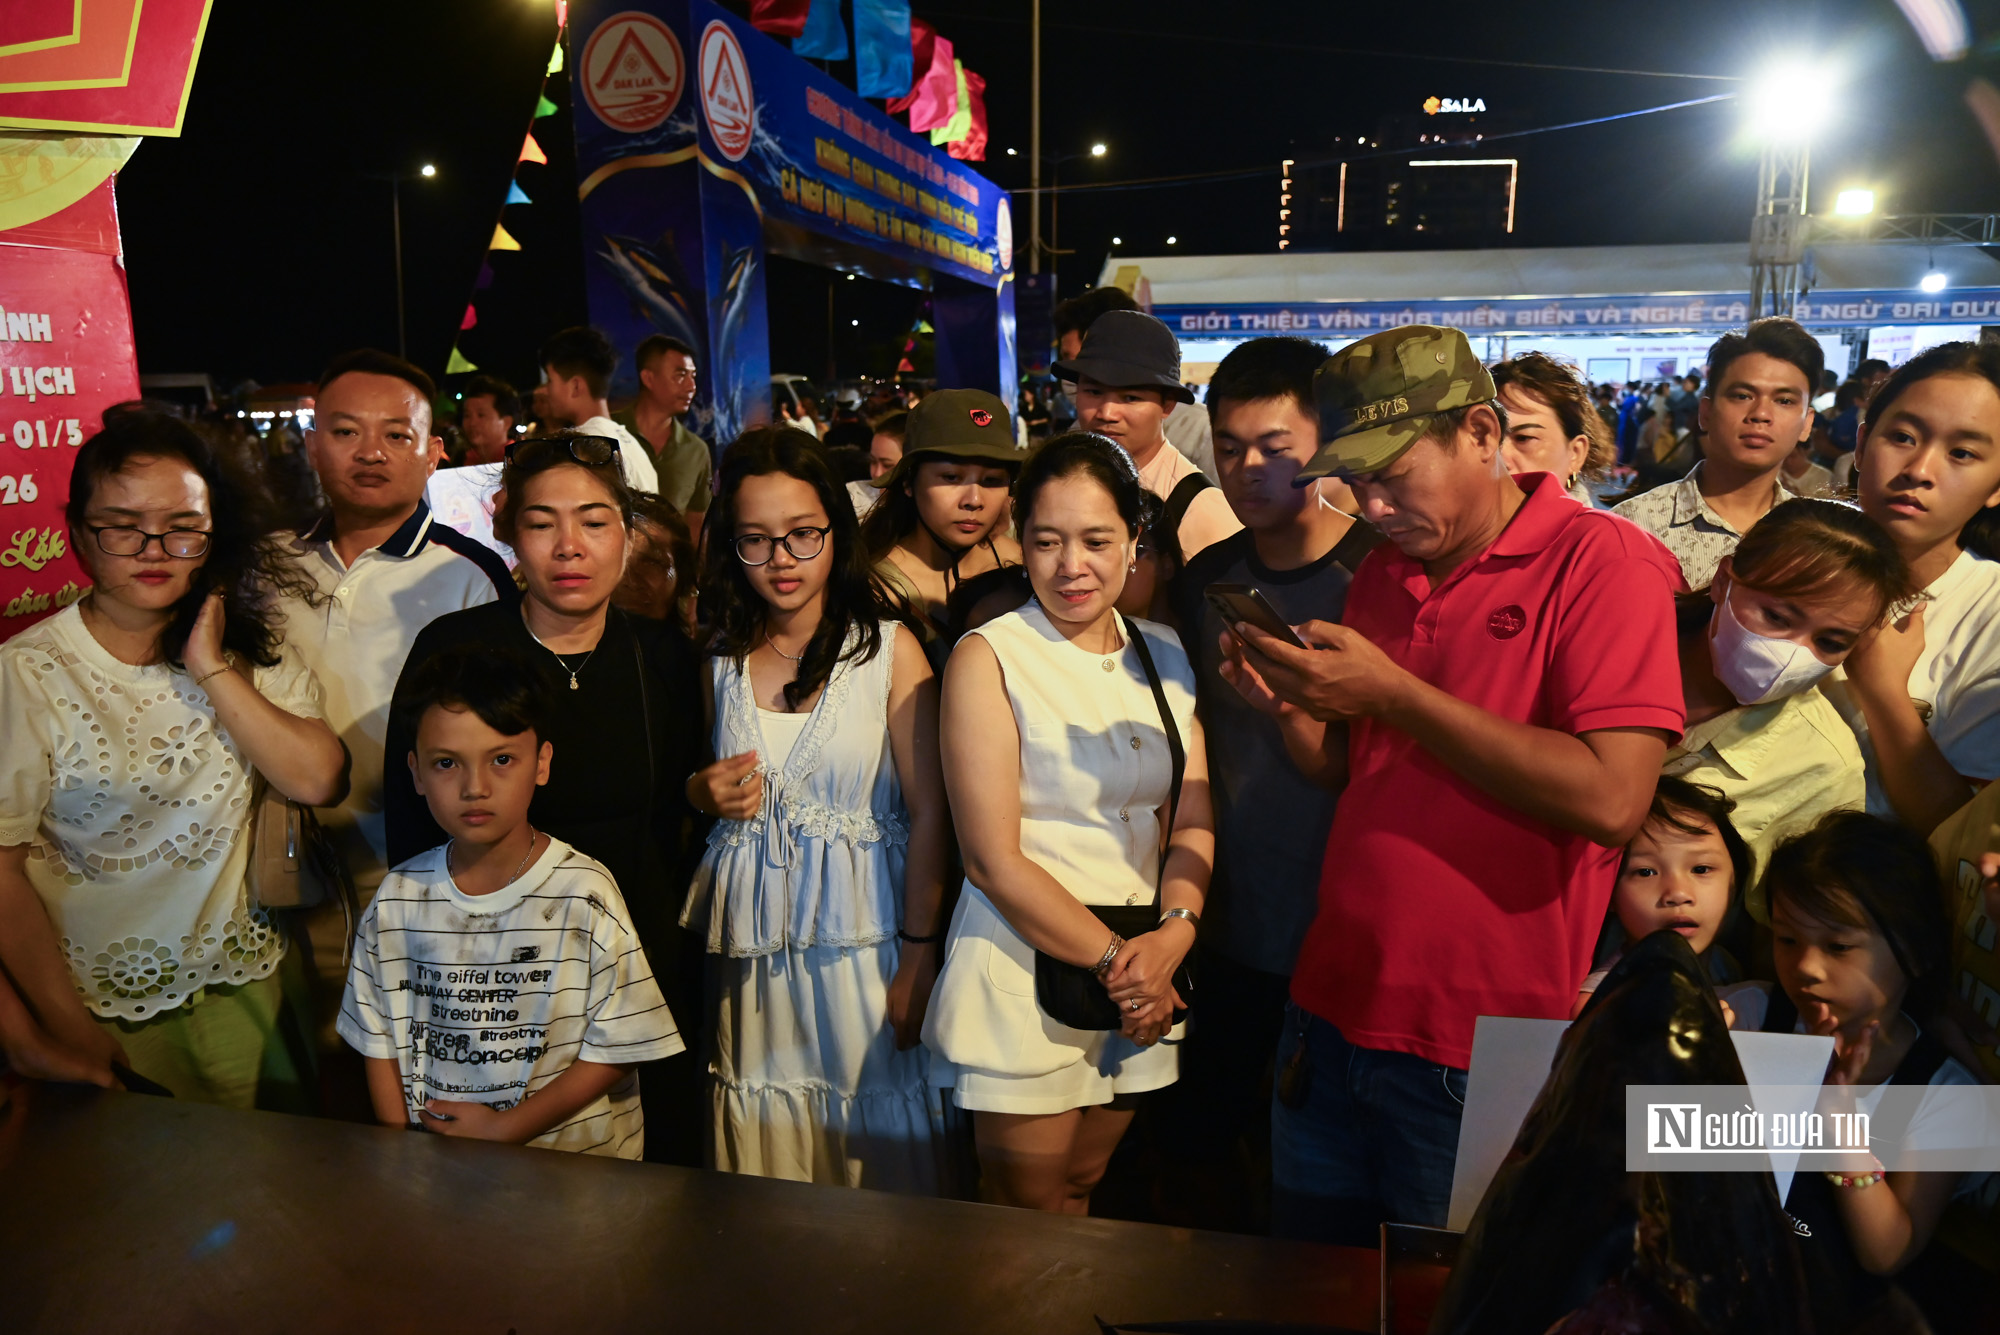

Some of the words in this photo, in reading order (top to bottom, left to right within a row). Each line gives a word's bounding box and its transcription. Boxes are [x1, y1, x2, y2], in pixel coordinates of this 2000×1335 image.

[1440, 97, 1487, 113] SALA
[1180, 310, 1230, 331] GIỚI
[1238, 309, 1309, 332] THIỆU
[1318, 309, 1370, 329] VĂN
[1515, 302, 1575, 325] BIỂN
[1585, 305, 1621, 325] VÀ
[1892, 301, 1941, 321] ĐẠI
[9, 366, 76, 403] LỊCH
[1354, 397, 1409, 424] LEVIS
[13, 418, 83, 449] 01/5
[416, 964, 442, 982] The
[447, 969, 490, 985] eiffel
[494, 969, 552, 984] tower
